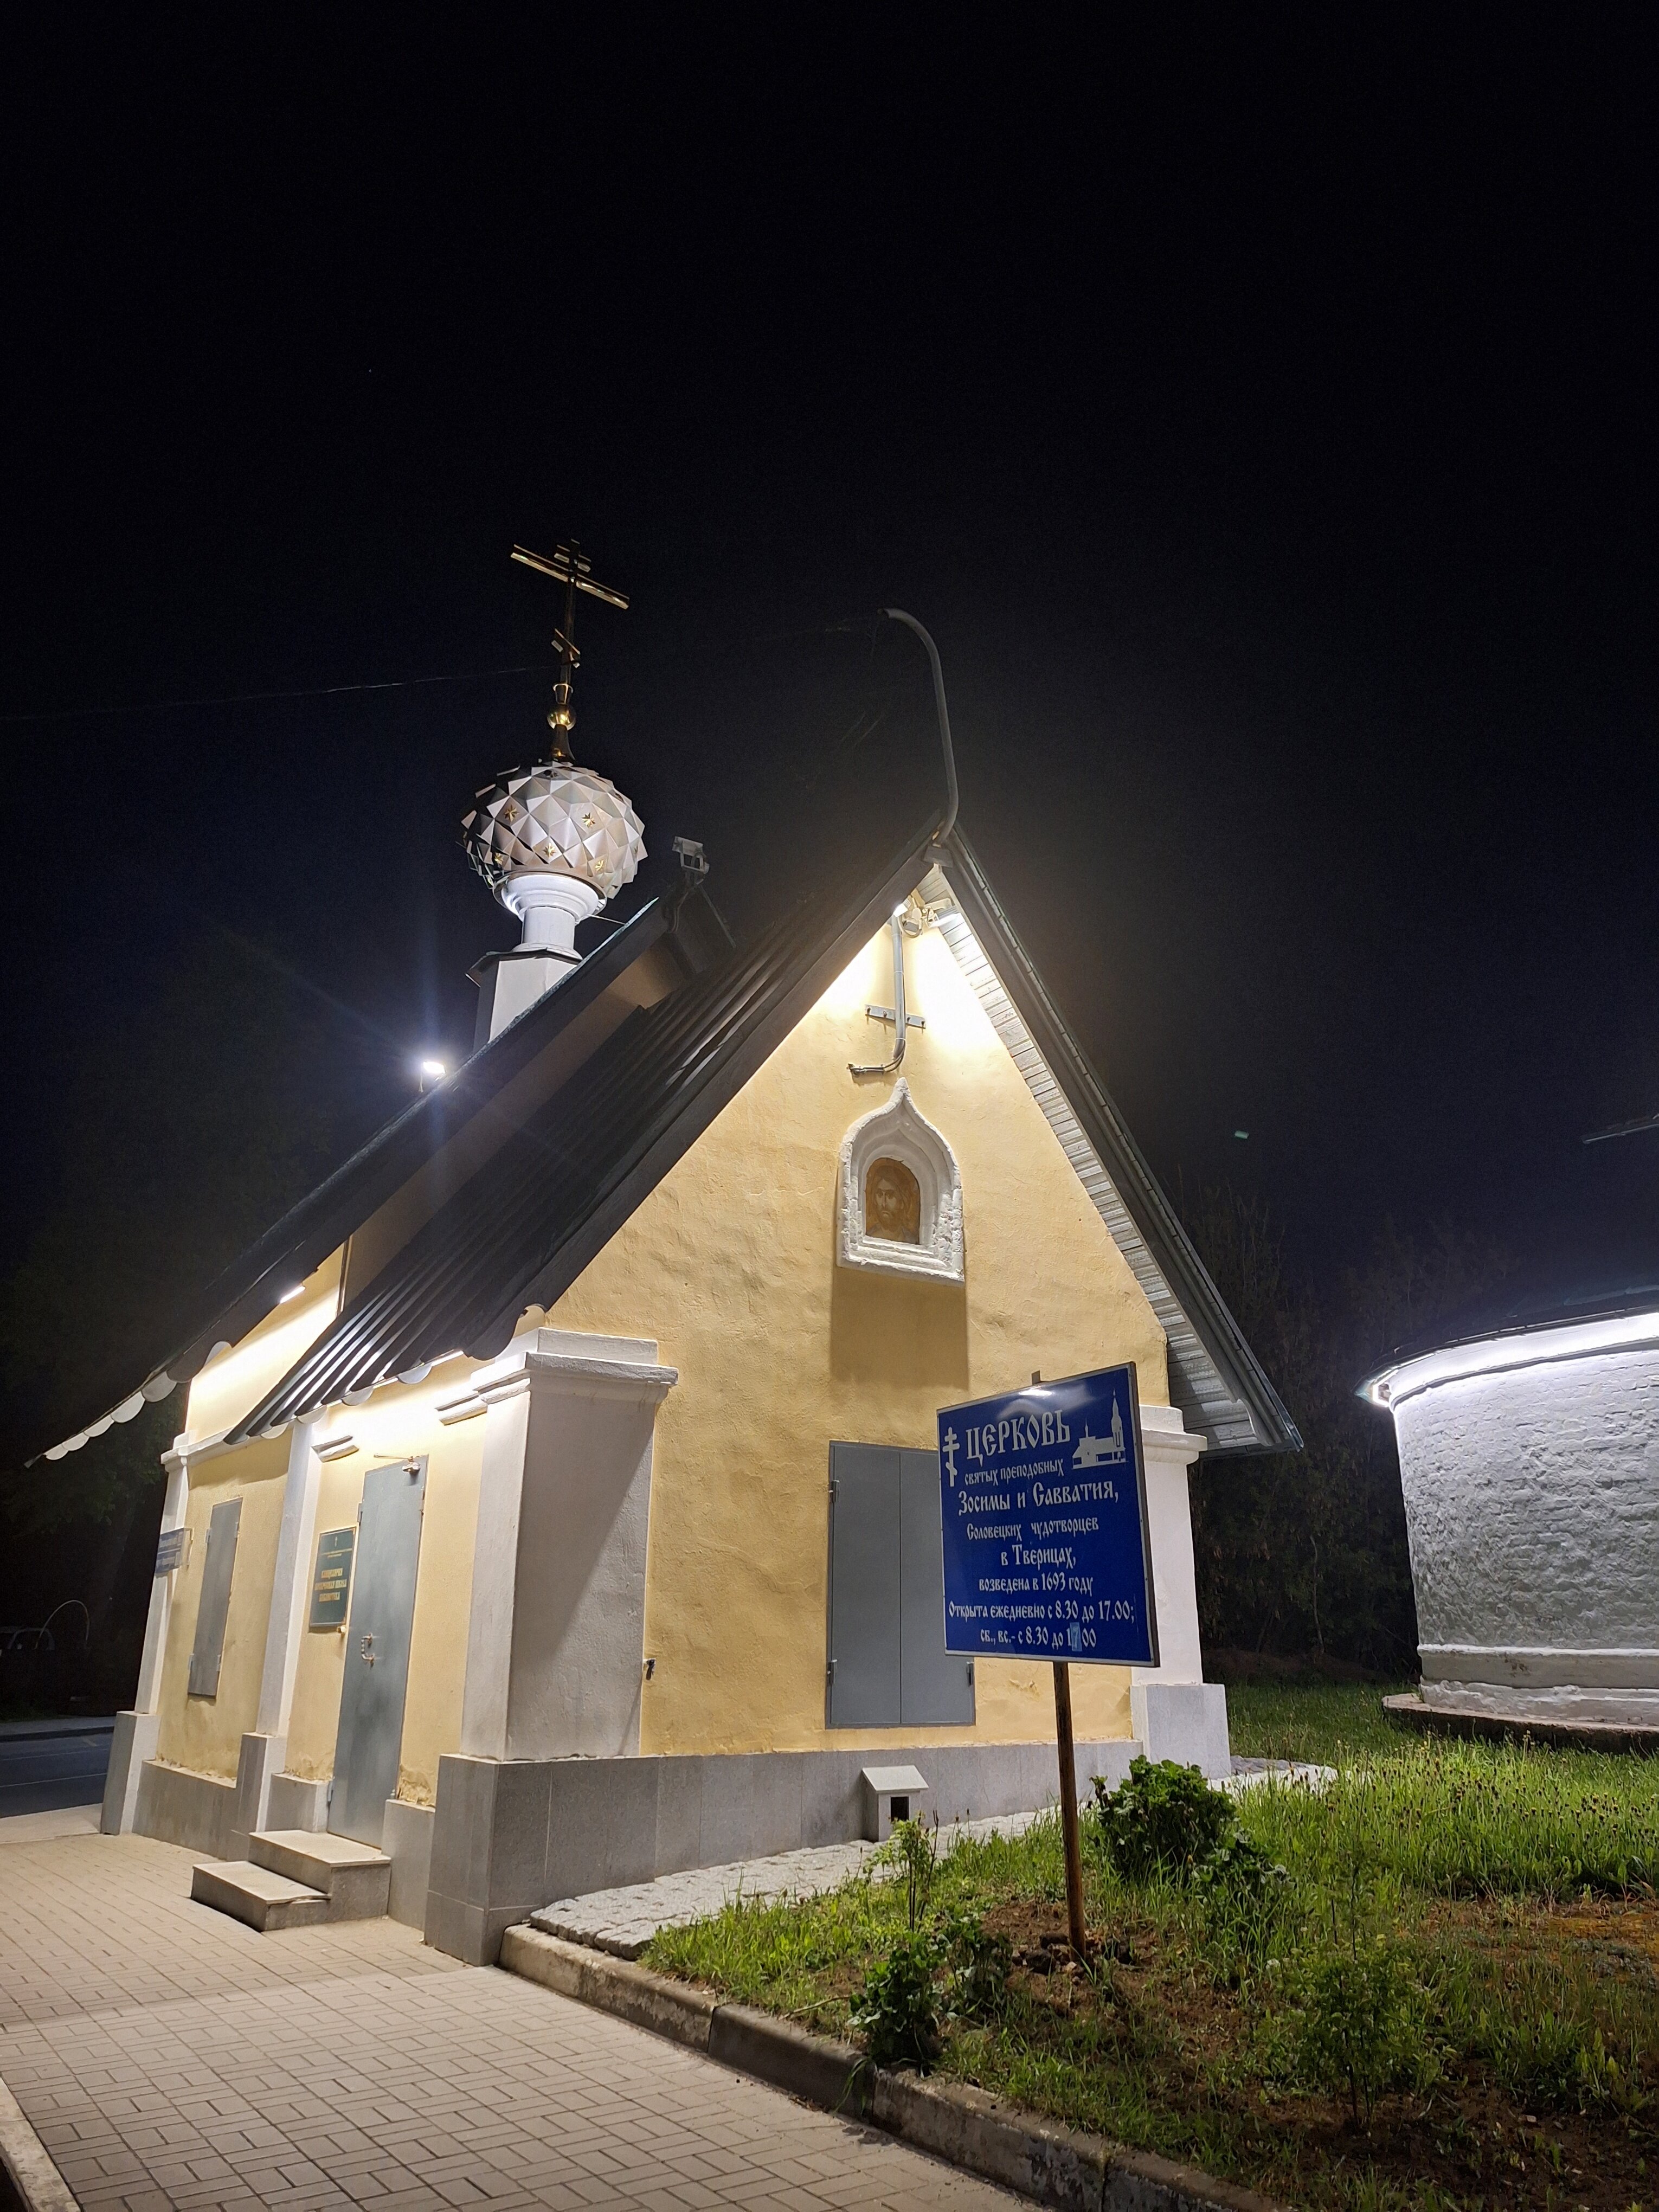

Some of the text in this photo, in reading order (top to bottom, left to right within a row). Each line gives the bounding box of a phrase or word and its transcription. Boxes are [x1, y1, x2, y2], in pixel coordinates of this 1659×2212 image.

[966, 1410, 1070, 1467] ЦЕРКОВЬ
[965, 1459, 1064, 1486] святых преподобных
[959, 1481, 1118, 1515] Зосимы и Савватия,
[967, 1517, 1098, 1541] Соловецких чудотворцев
[1001, 1545, 1076, 1570] в Тверицах,
[980, 1572, 1092, 1596] возведена в 1693 году
[949, 1601, 988, 1622] Открыта
[991, 1605, 1045, 1621] ежедневно
[1048, 1606, 1052, 1618] с
[1056, 1600, 1078, 1619] 8.30
[1082, 1606, 1094, 1623] до
[1018, 1631, 1023, 1643] с
[1026, 1626, 1048, 1644] 8.30
[1052, 1632, 1063, 1649] до
